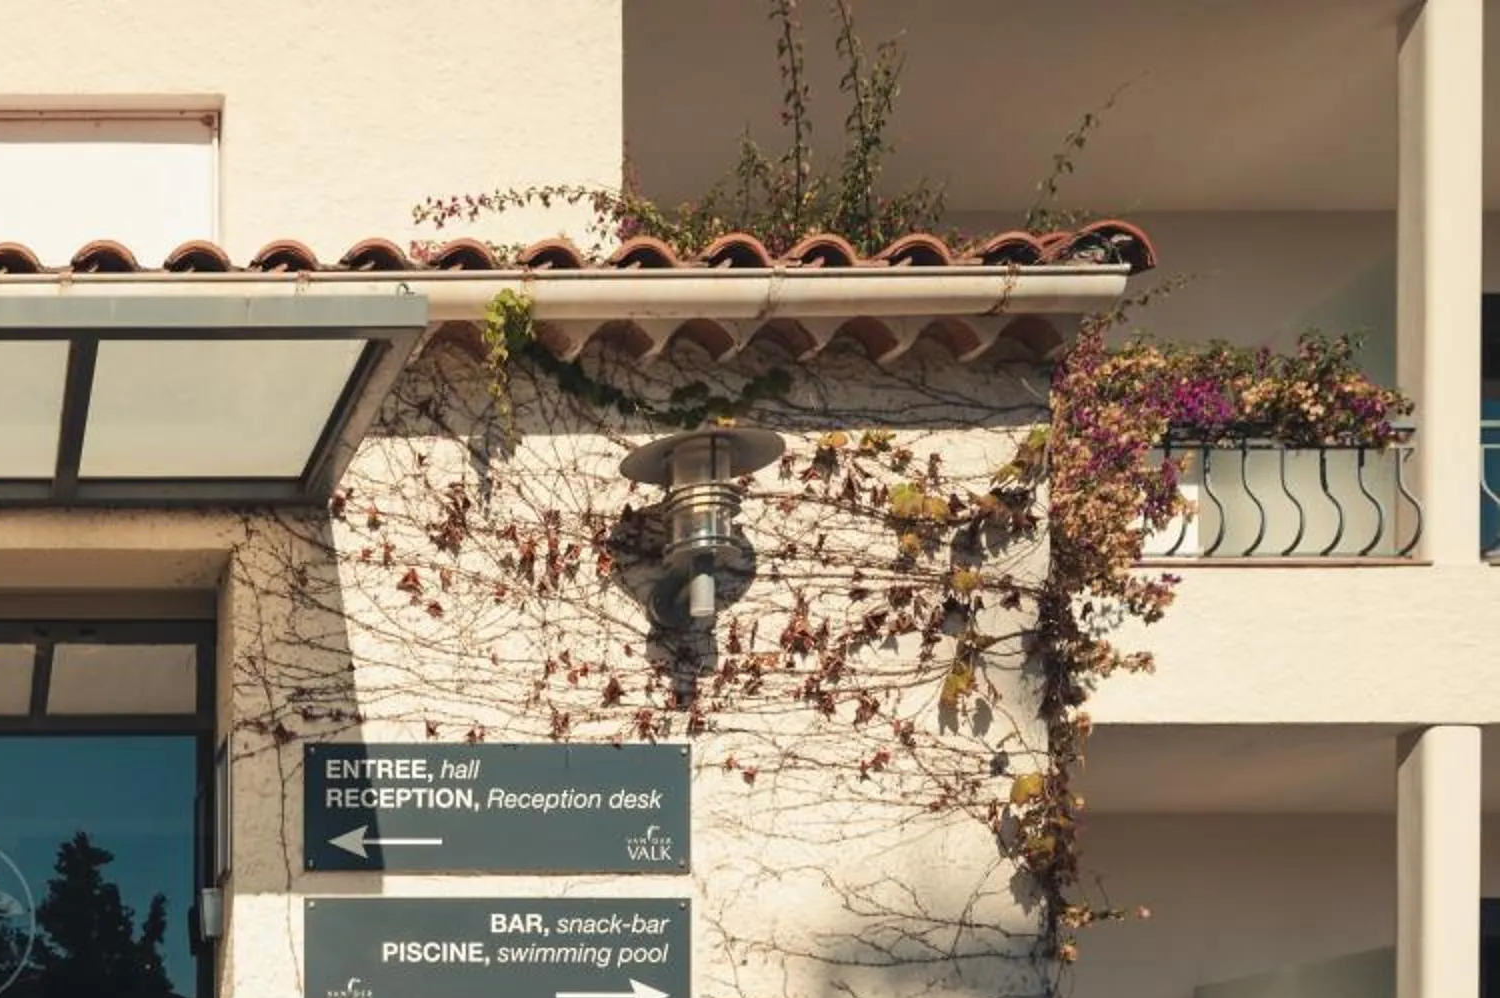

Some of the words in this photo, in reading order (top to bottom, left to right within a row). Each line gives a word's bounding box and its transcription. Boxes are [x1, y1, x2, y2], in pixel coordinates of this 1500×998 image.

[325, 759, 434, 783] ENTREE,
[440, 759, 481, 780] hall
[325, 787, 481, 812] RECEPTION,
[487, 788, 602, 814] Reception
[608, 788, 663, 810] desk
[627, 845, 672, 861] VALK
[490, 913, 550, 936] BAR,
[556, 912, 671, 934] snack-bar
[381, 942, 490, 966] PISCINE,
[497, 943, 612, 968] swimming
[617, 942, 670, 968] pool
